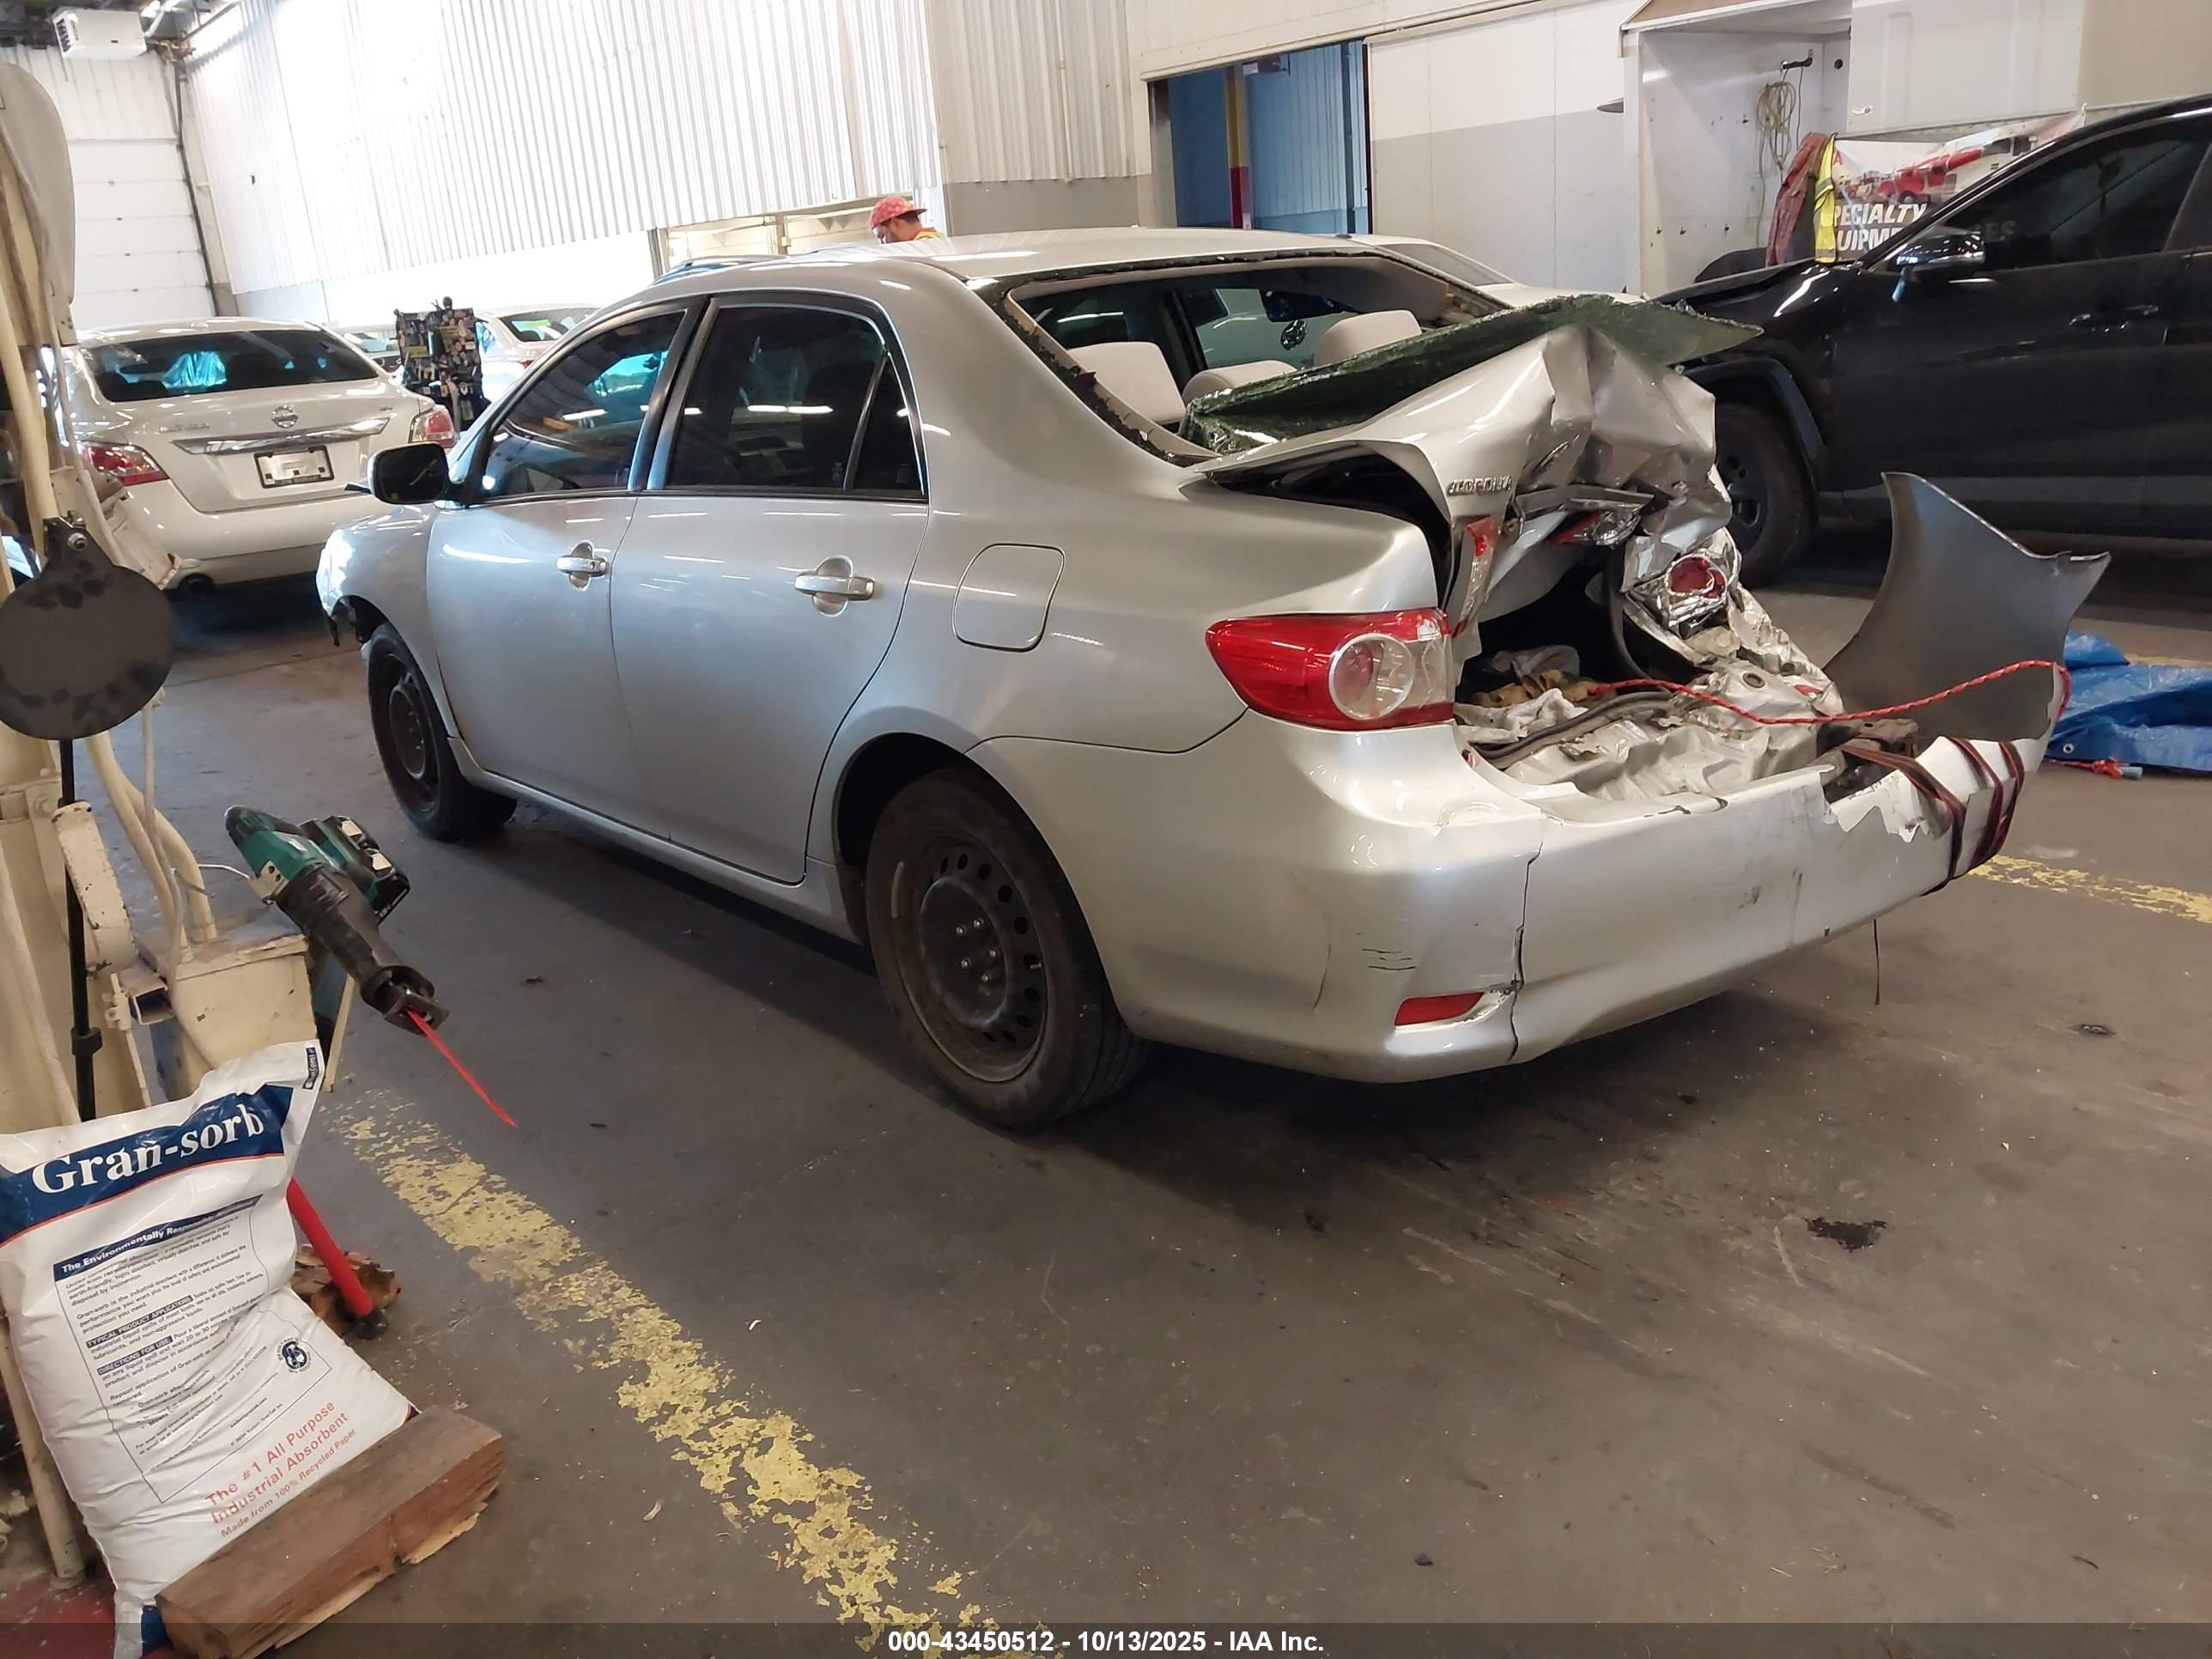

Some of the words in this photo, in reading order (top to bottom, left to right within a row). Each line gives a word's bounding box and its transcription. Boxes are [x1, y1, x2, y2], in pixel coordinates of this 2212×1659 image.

[1834, 203, 1928, 227] PECIALTY
[32, 1103, 264, 1194] Gran-sorb
[62, 1263, 82, 1273] The
[83, 1230, 164, 1266] Environmentally
[76, 1304, 109, 1320] Gran-sorb
[79, 1306, 121, 1328] performance
[122, 1300, 134, 1309] you
[136, 1293, 150, 1302] want
[82, 1316, 117, 1334] protection
[118, 1310, 130, 1319] you
[87, 1330, 117, 1346] TYPICAL
[117, 1315, 149, 1333] PRODUCT
[129, 1335, 141, 1345] and
[98, 1352, 141, 1374] DIRECTIONS
[140, 1344, 155, 1354] FOR
[159, 1346, 170, 1355] and
[105, 1373, 130, 1389] product
[132, 1366, 144, 1376] and
[145, 1355, 168, 1369] dispose
[110, 1388, 134, 1401] Repeat
[135, 1370, 169, 1389] application
[204, 1483, 239, 1506] The
[241, 1462, 262, 1480] #1
[266, 1443, 286, 1464] All
[286, 1401, 336, 1446] Purpose
[211, 1468, 283, 1523] Industrial
[286, 1413, 349, 1470] Absorbent
[221, 1517, 249, 1537] Made
[251, 1499, 273, 1516] from
[276, 1480, 298, 1498] 100%
[298, 1448, 334, 1480] Recycled
[334, 1429, 356, 1449] Paper
